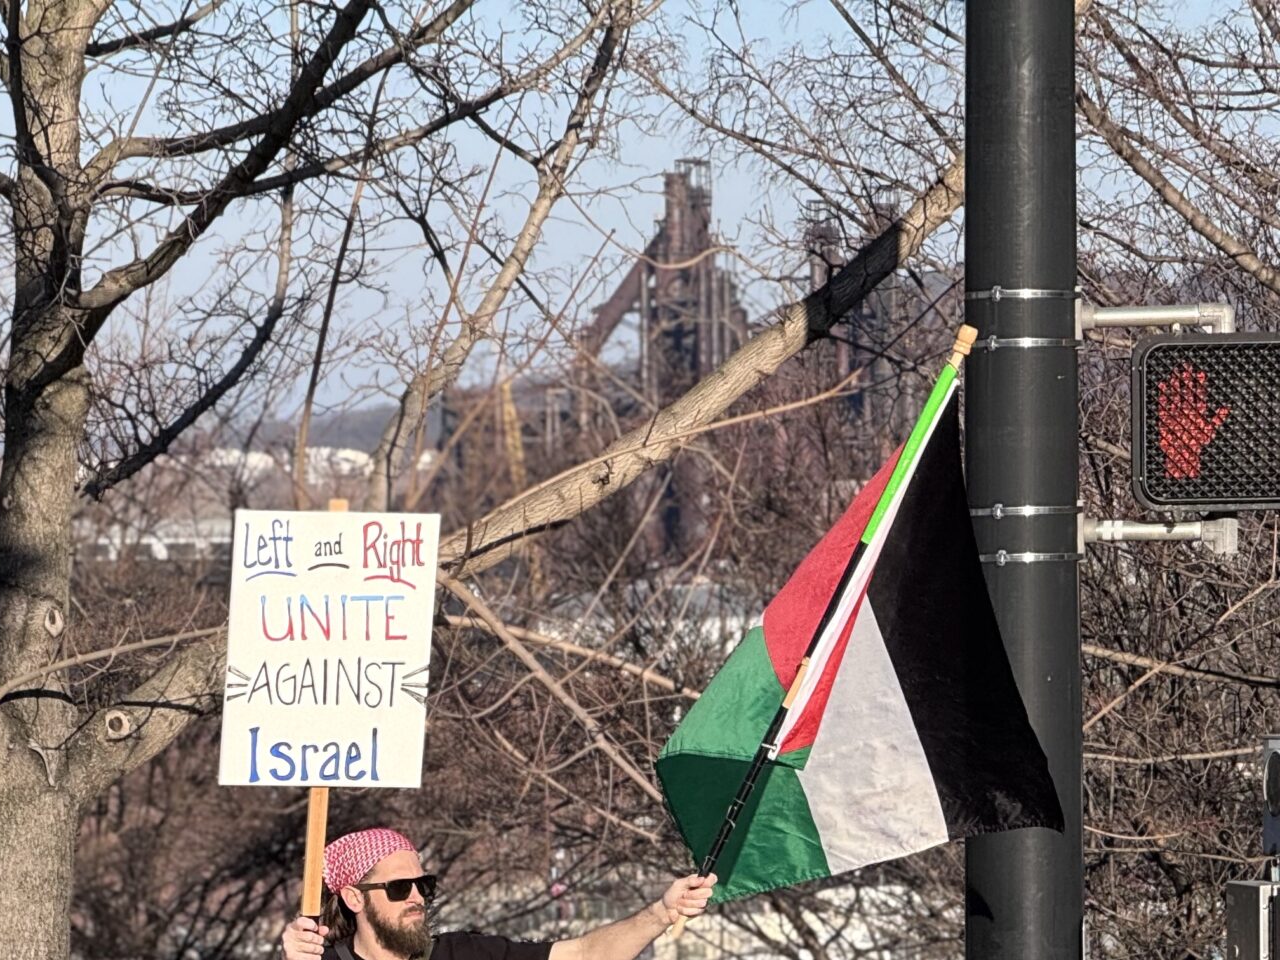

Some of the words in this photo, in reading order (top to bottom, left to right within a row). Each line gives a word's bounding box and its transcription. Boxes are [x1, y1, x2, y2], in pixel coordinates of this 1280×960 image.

[243, 520, 293, 569] Left
[314, 533, 342, 557] and
[363, 521, 424, 582] Right
[261, 595, 407, 641] UNITE
[248, 657, 405, 708] AGAINST
[248, 727, 379, 782] Israel
